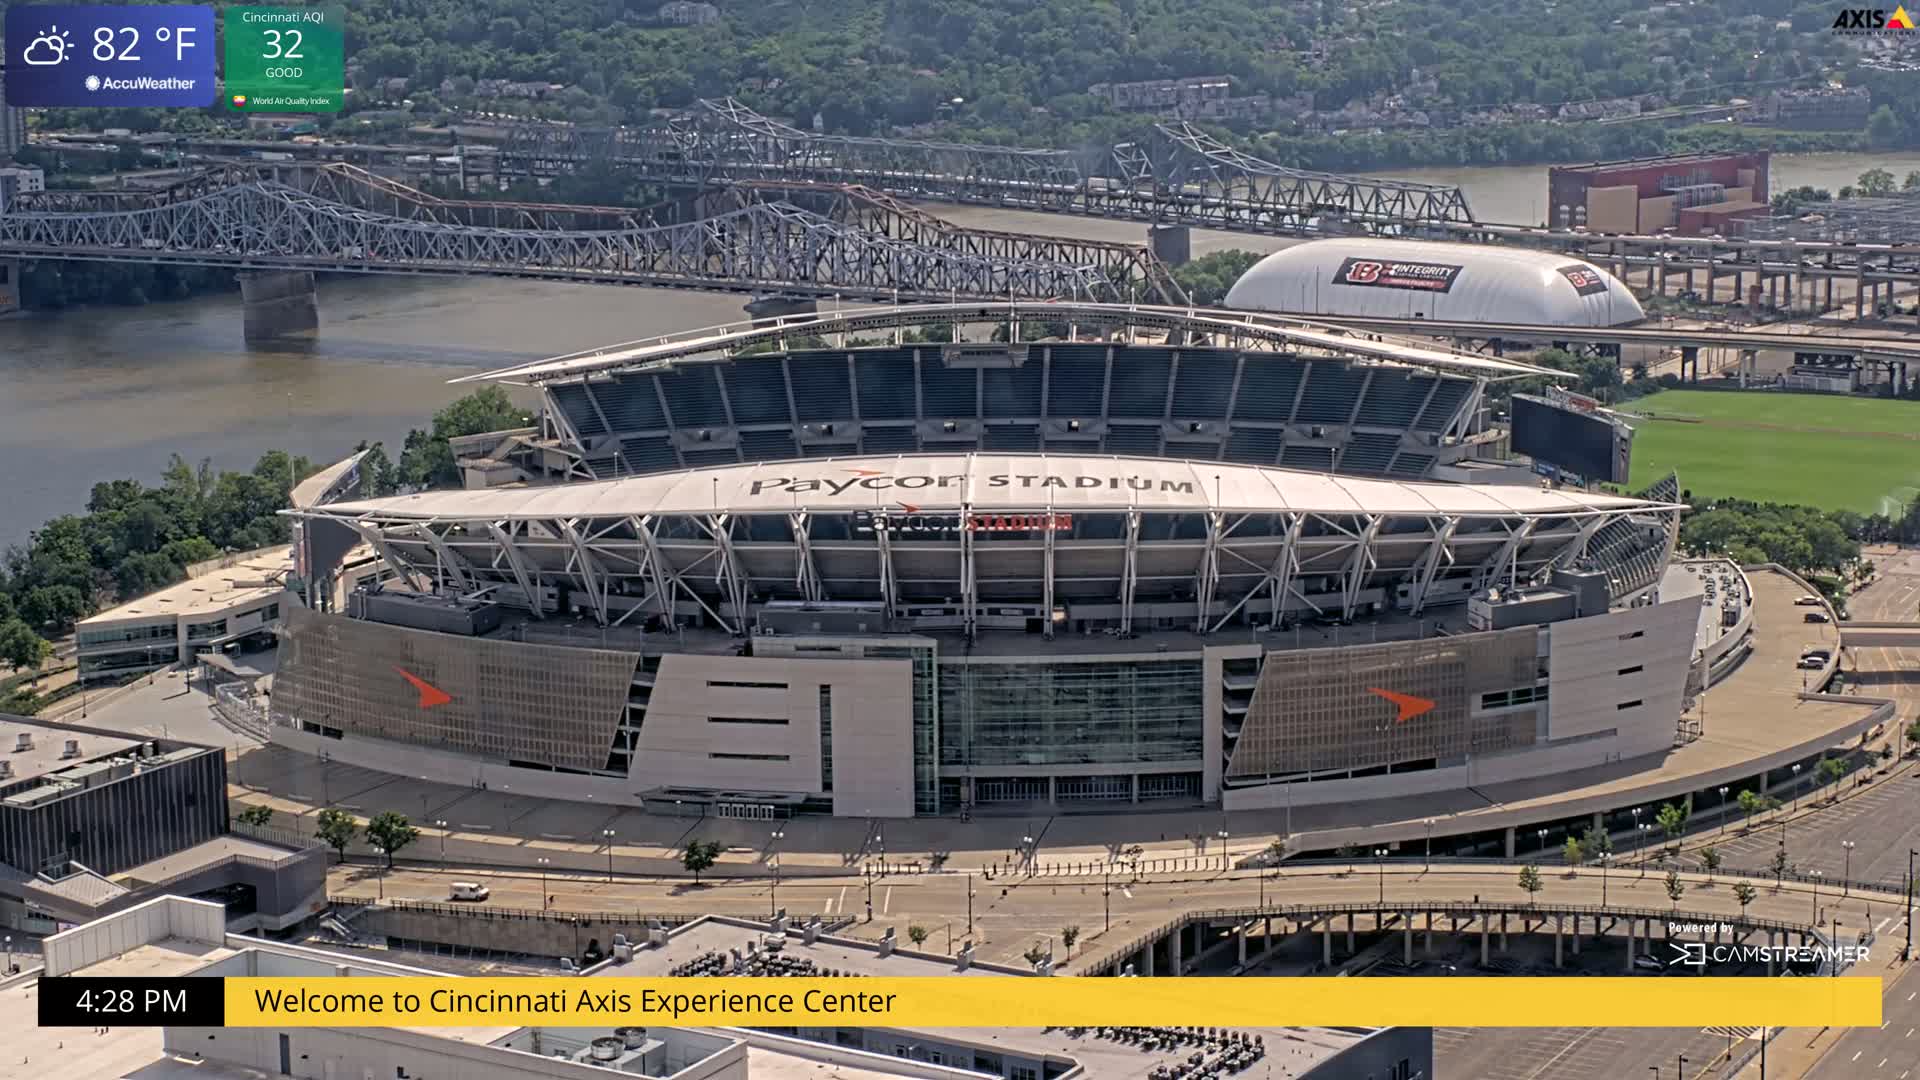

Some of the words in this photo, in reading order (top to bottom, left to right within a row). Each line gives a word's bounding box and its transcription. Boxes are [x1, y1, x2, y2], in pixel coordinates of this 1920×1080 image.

[1396, 263, 1455, 277] INTEGRITY
[988, 474, 1194, 494] STADIUM
[966, 514, 1073, 531] STADIUM
